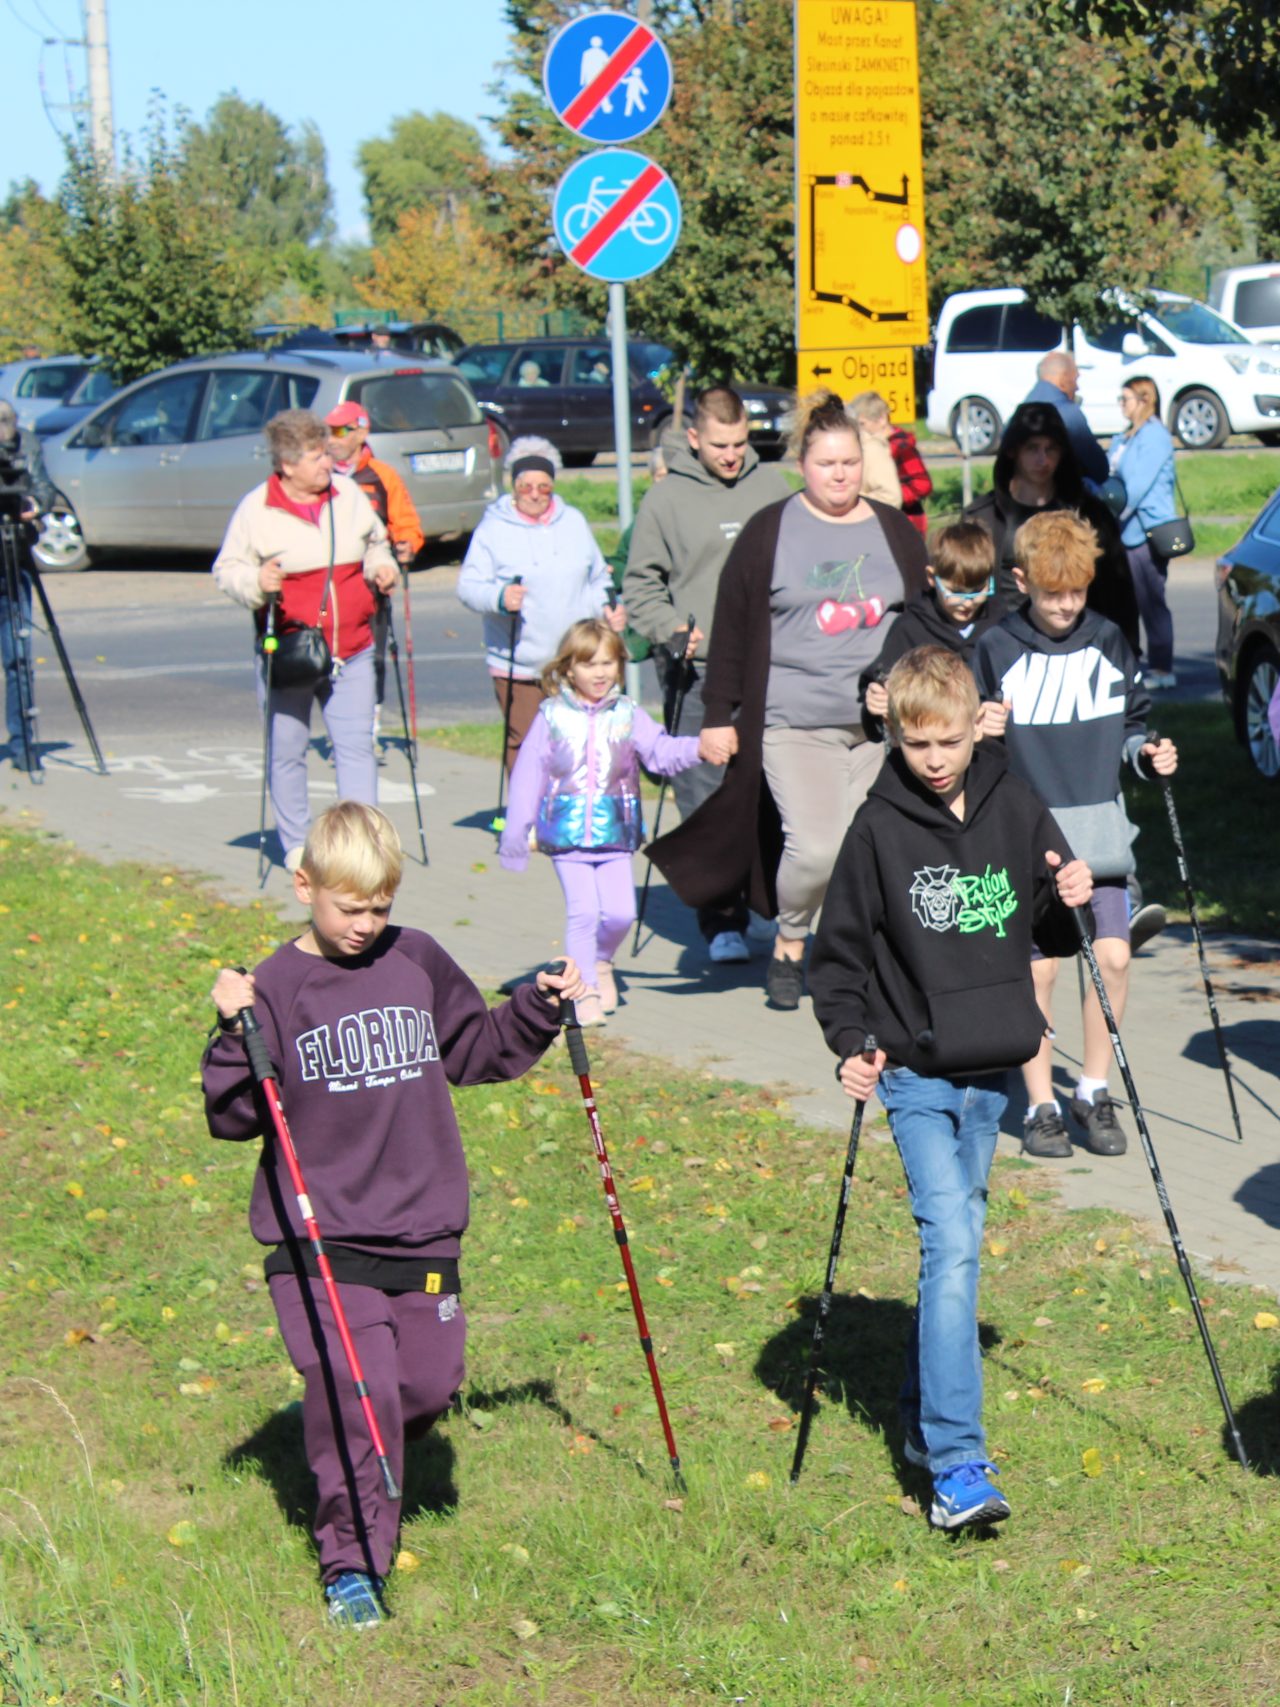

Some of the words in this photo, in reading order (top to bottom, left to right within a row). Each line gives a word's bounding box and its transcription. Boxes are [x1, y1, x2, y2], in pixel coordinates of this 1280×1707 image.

[831, 6, 888, 26] UWAGA!
[804, 79, 843, 100] Objazd
[830, 131, 864, 149] ponad
[842, 354, 908, 385] Objazd
[904, 393, 911, 413] t
[1001, 646, 1126, 725] NIKE
[295, 1006, 441, 1082] FLORIDA
